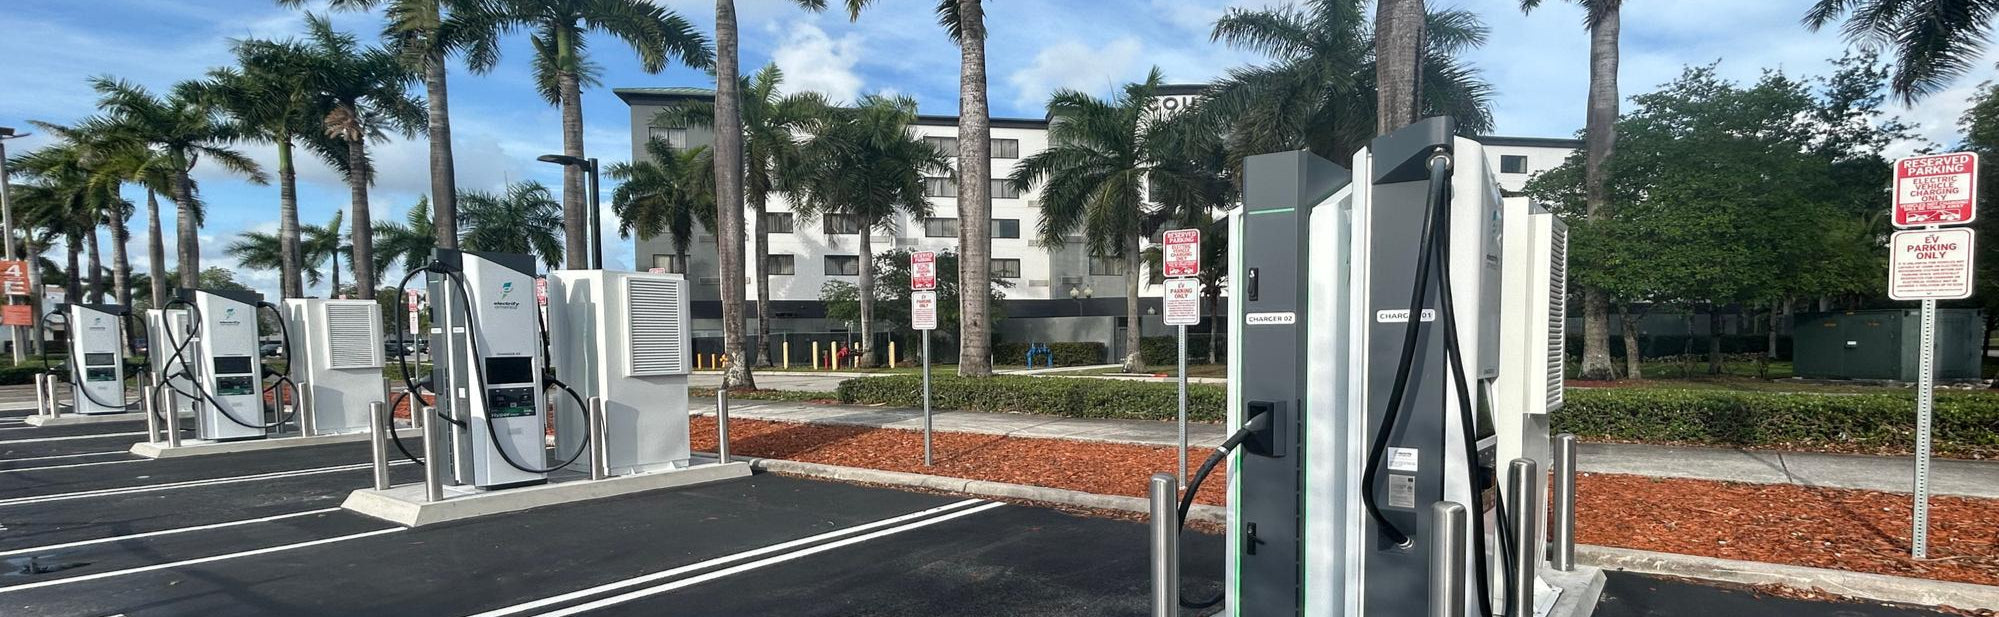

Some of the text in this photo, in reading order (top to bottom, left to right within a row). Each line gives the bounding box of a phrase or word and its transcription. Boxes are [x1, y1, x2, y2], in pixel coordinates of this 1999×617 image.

[1904, 156, 1969, 168] RESERVED
[1908, 164, 1964, 176] PARKING
[1913, 176, 1958, 184] ELECTRIC
[1915, 182, 1954, 190] VEHICLE
[1910, 188, 1959, 196] CHARGING
[1925, 236, 1939, 244] EV
[1907, 243, 1957, 252] PARKING
[4, 264, 23, 277] 4
[4, 281, 26, 295] E
[1248, 315, 1282, 323] CHARGER
[1379, 312, 1410, 320] CHARG
